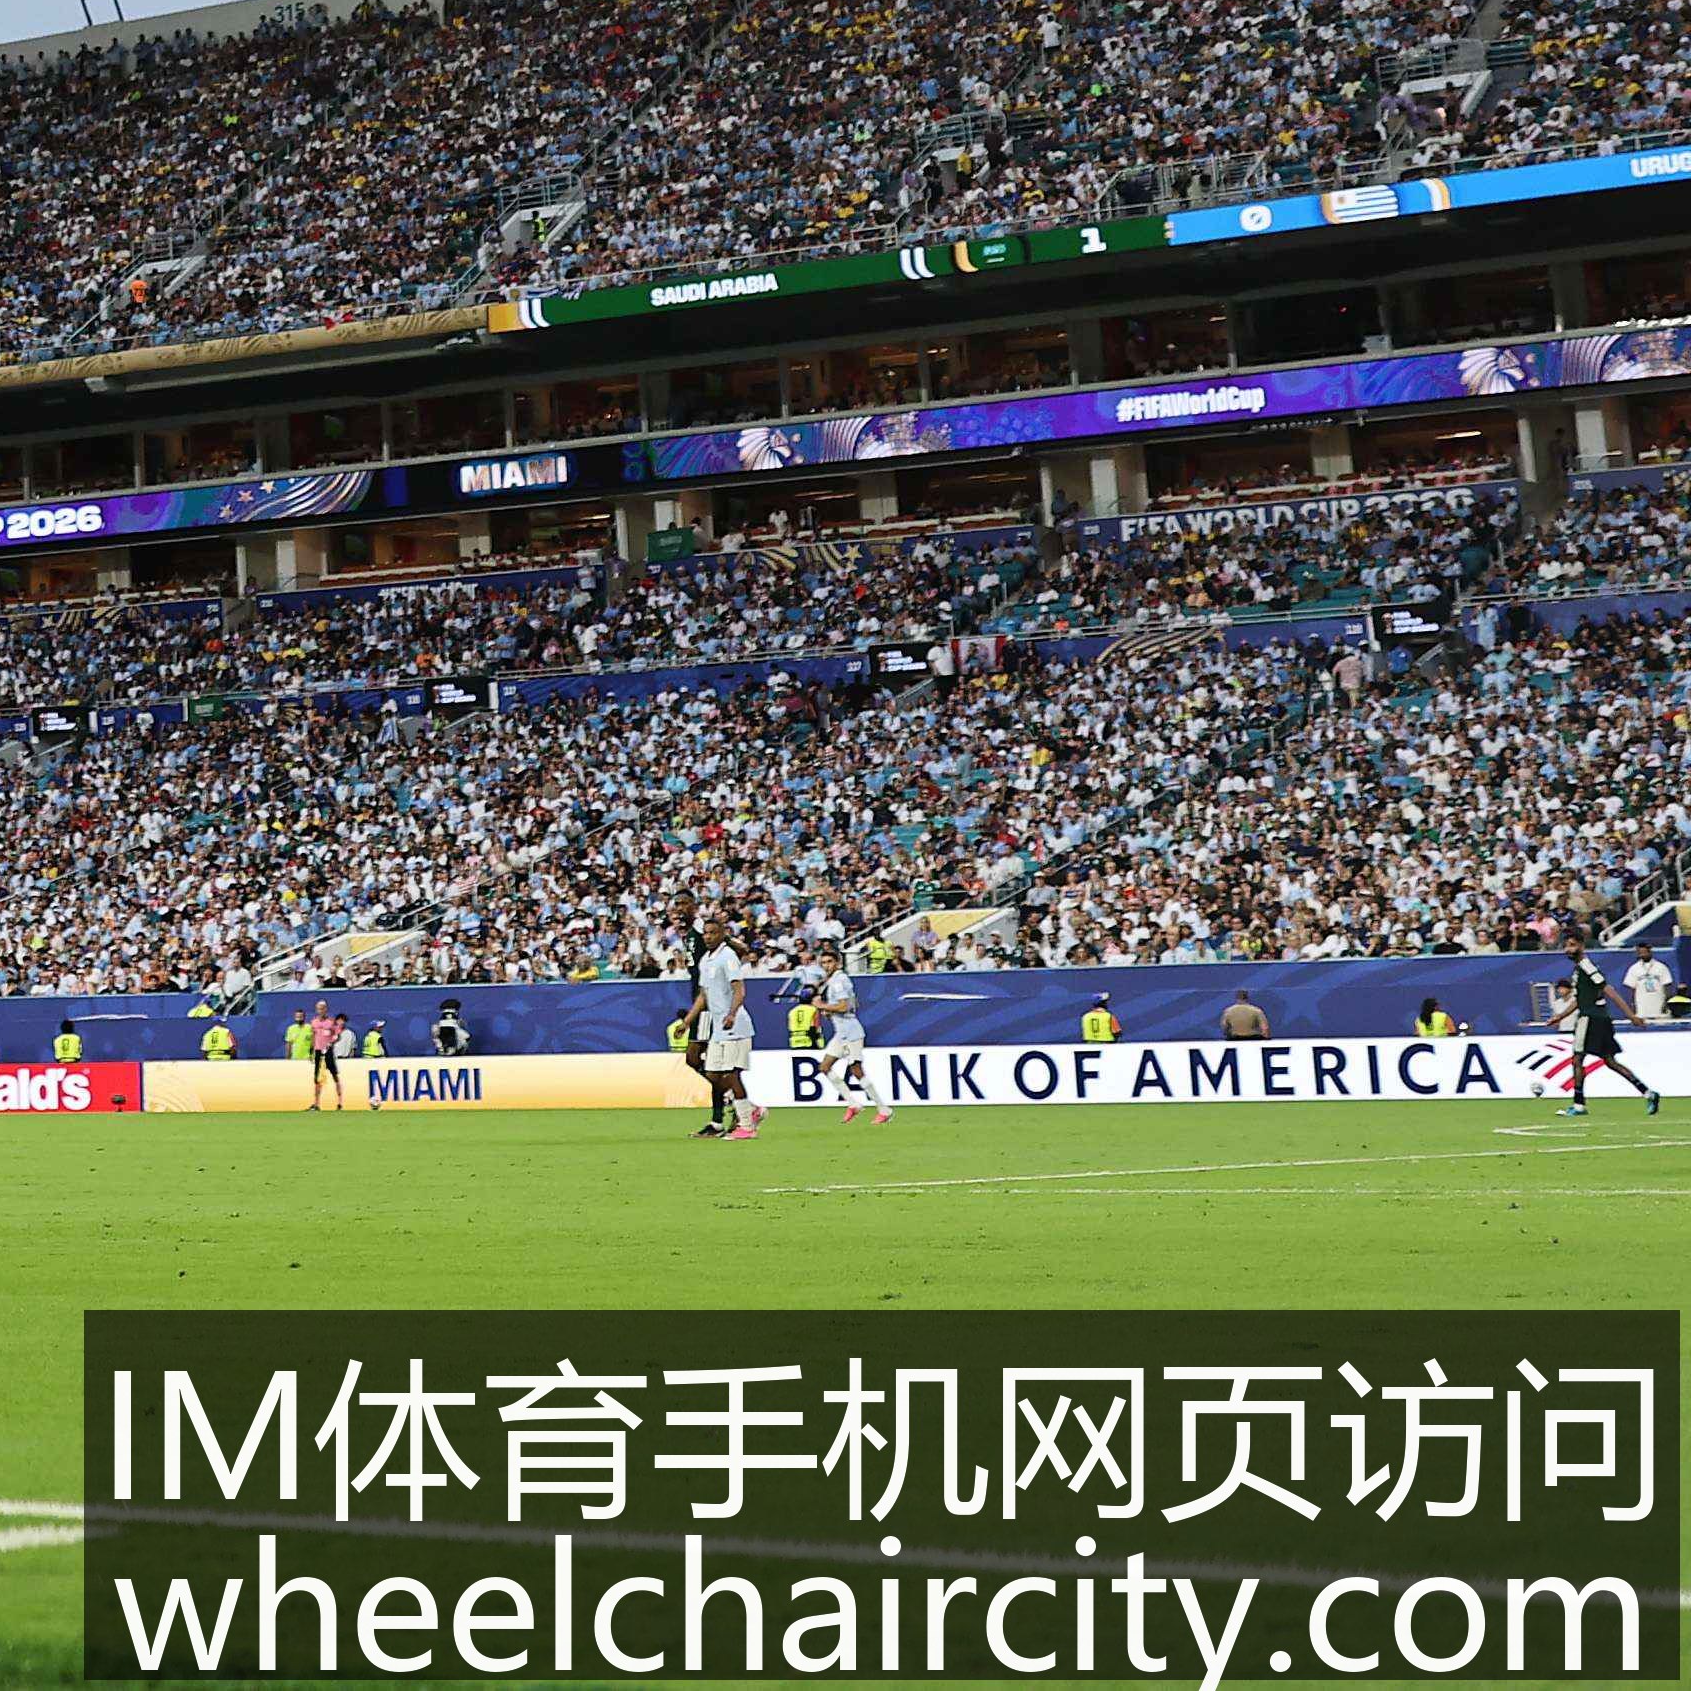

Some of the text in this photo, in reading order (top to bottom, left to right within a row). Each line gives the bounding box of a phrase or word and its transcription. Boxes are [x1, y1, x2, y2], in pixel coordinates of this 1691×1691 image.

[274, 2, 305, 23] 315
[1080, 227, 1107, 255] 1
[649, 273, 779, 307] SAUDI ARABIA
[1116, 386, 1266, 422] #FIFAWorldCup
[460, 456, 568, 493] MIAMI
[6, 505, 103, 539] 2026
[1121, 515, 1182, 541] FIFA
[368, 1068, 482, 1102] MIAMI
[791, 1043, 1503, 1102] BANK OF AMERICA
